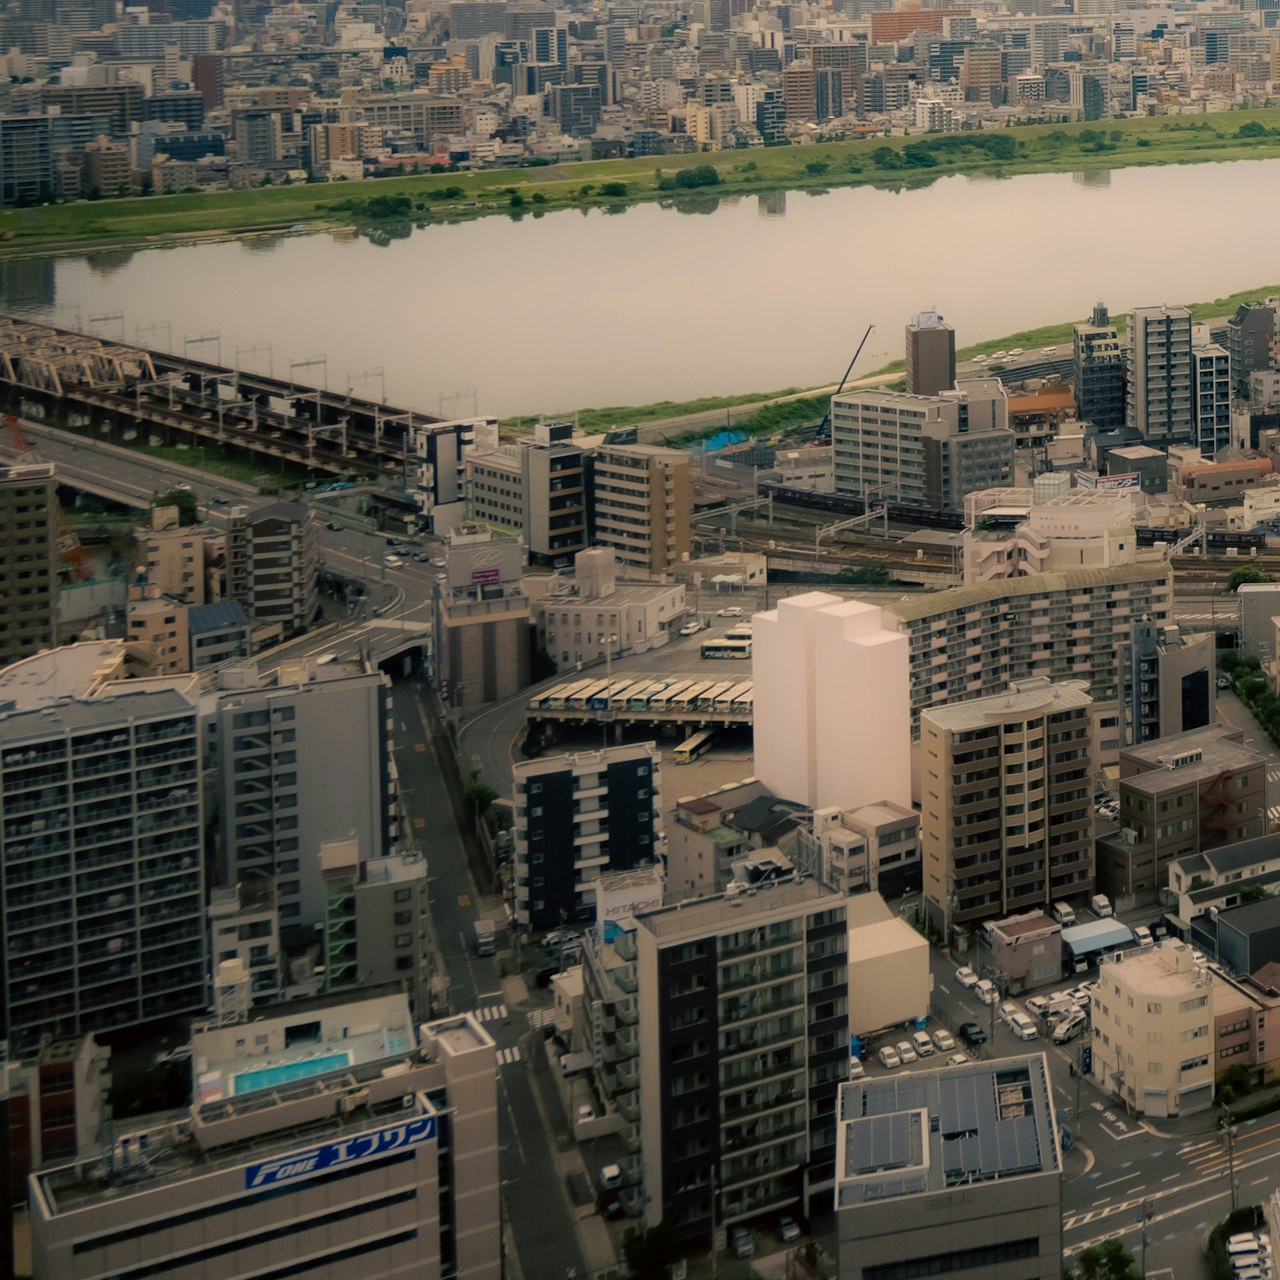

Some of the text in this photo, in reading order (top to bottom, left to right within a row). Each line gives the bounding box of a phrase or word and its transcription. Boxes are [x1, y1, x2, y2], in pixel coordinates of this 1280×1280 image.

[606, 898, 660, 916] HITACHI
[250, 1119, 432, 1187] FONE エフワン
